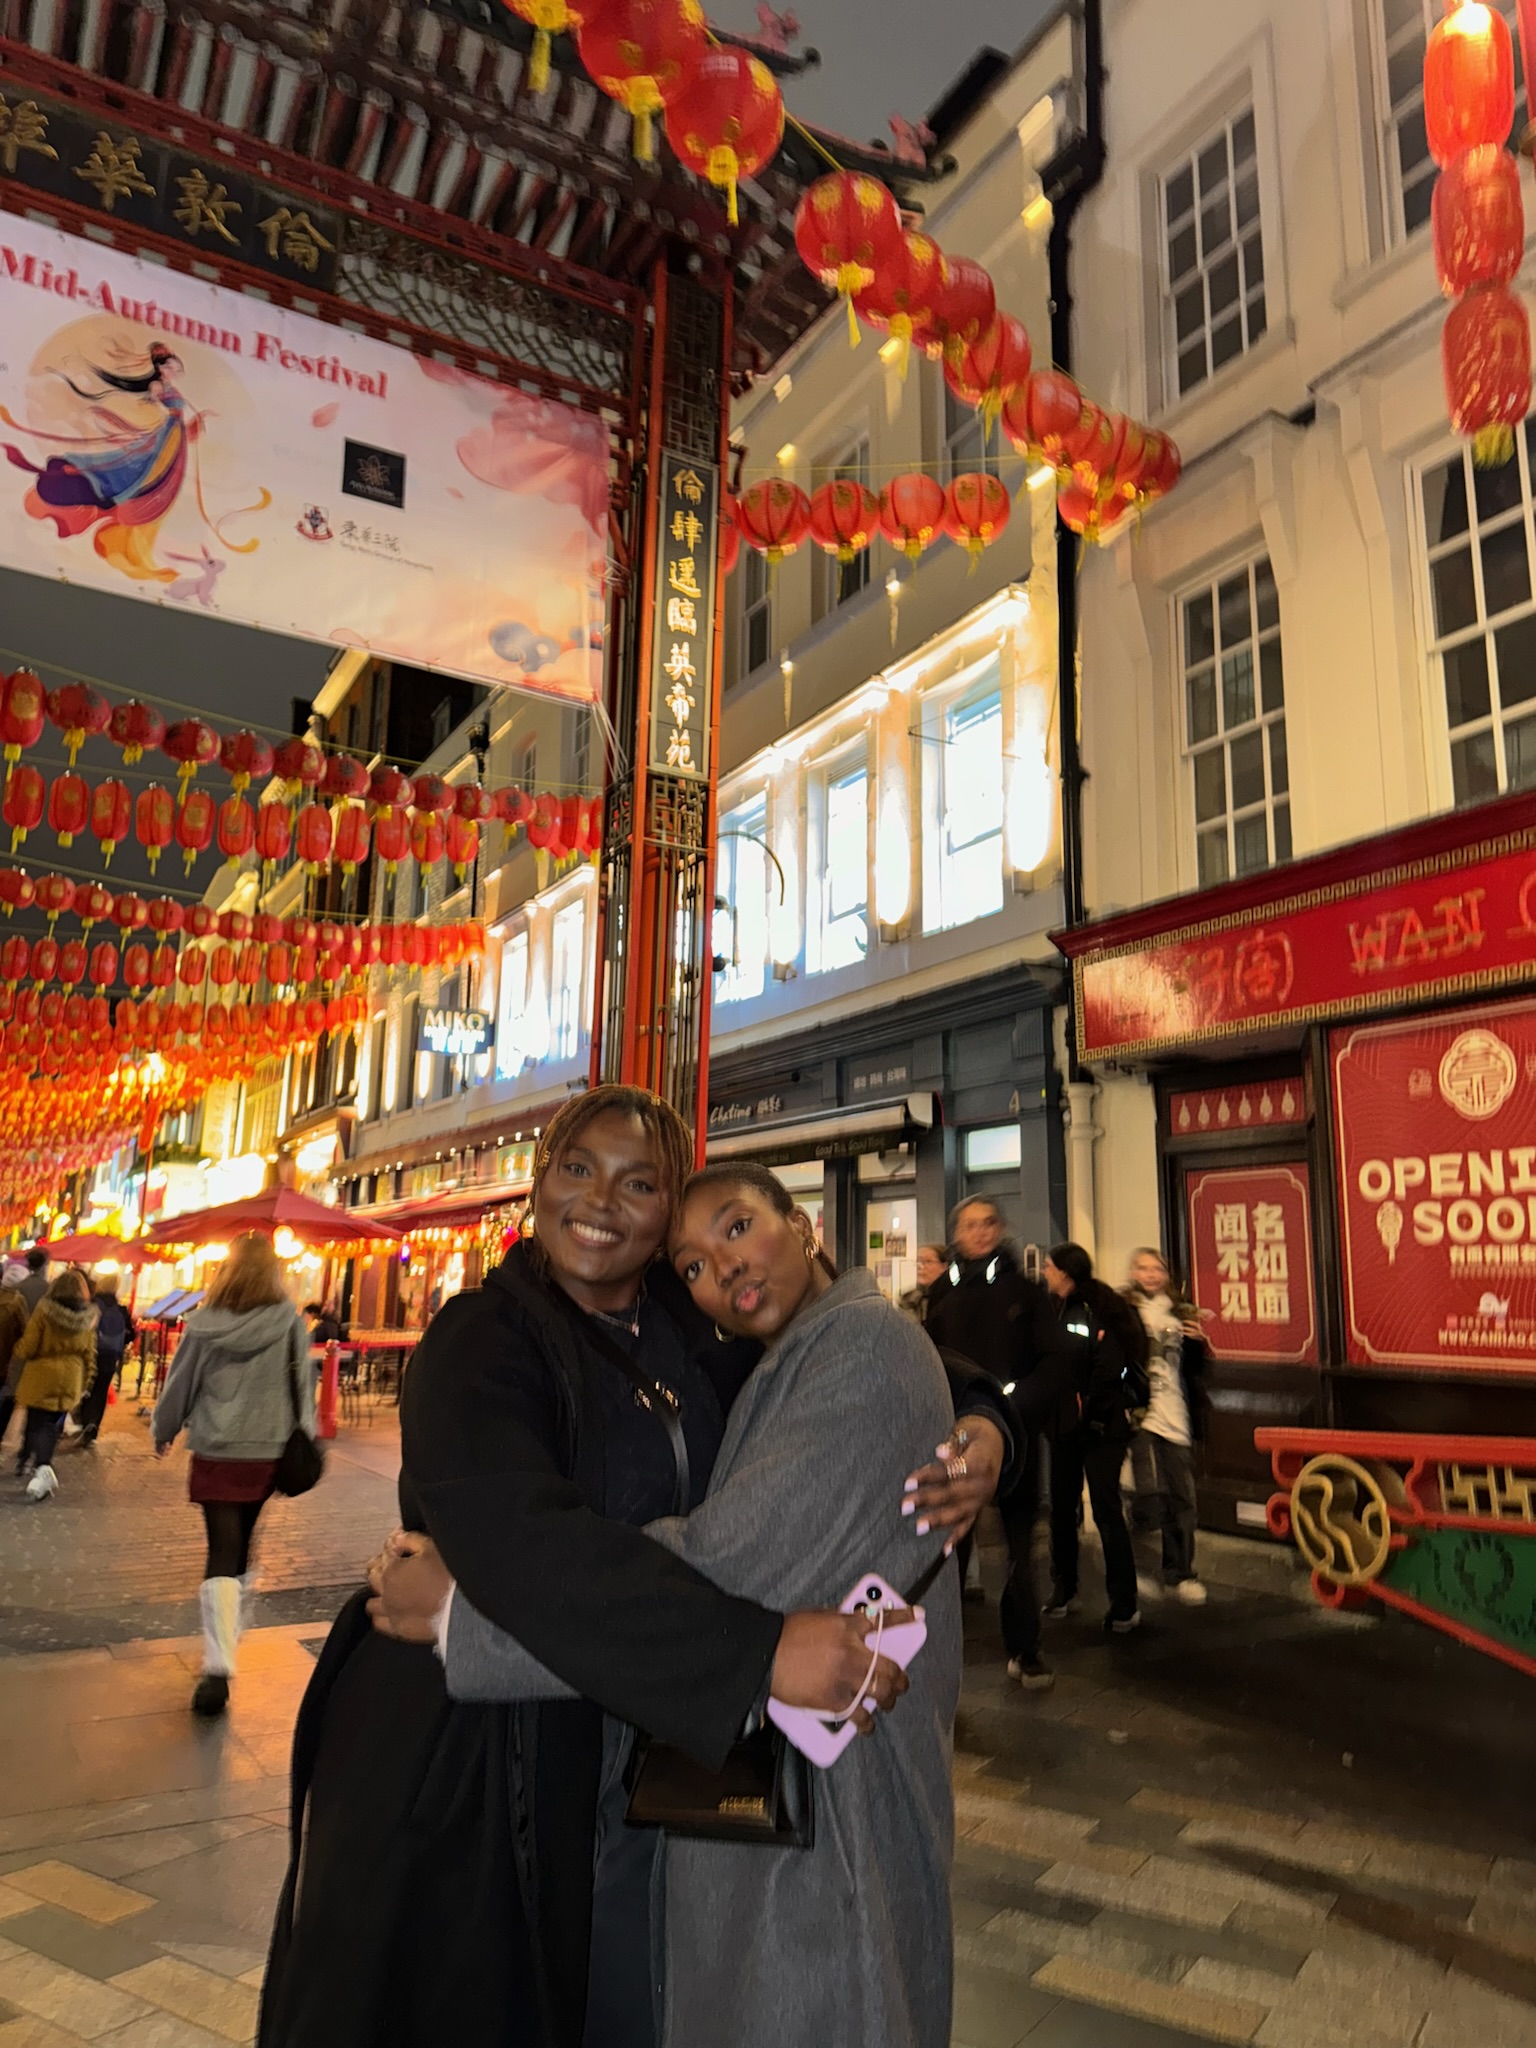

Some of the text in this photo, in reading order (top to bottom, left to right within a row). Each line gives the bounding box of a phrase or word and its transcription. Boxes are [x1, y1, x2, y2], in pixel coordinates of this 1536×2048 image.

[0, 246, 389, 400] Mid-Autumn Festival
[1347, 888, 1486, 977] WAN
[423, 1008, 485, 1031] MIKO
[710, 1103, 753, 1125] Chatime
[1214, 1201, 1285, 1242] 闻名
[1216, 1241, 1288, 1281] 不如
[1219, 1281, 1290, 1324] 见面
